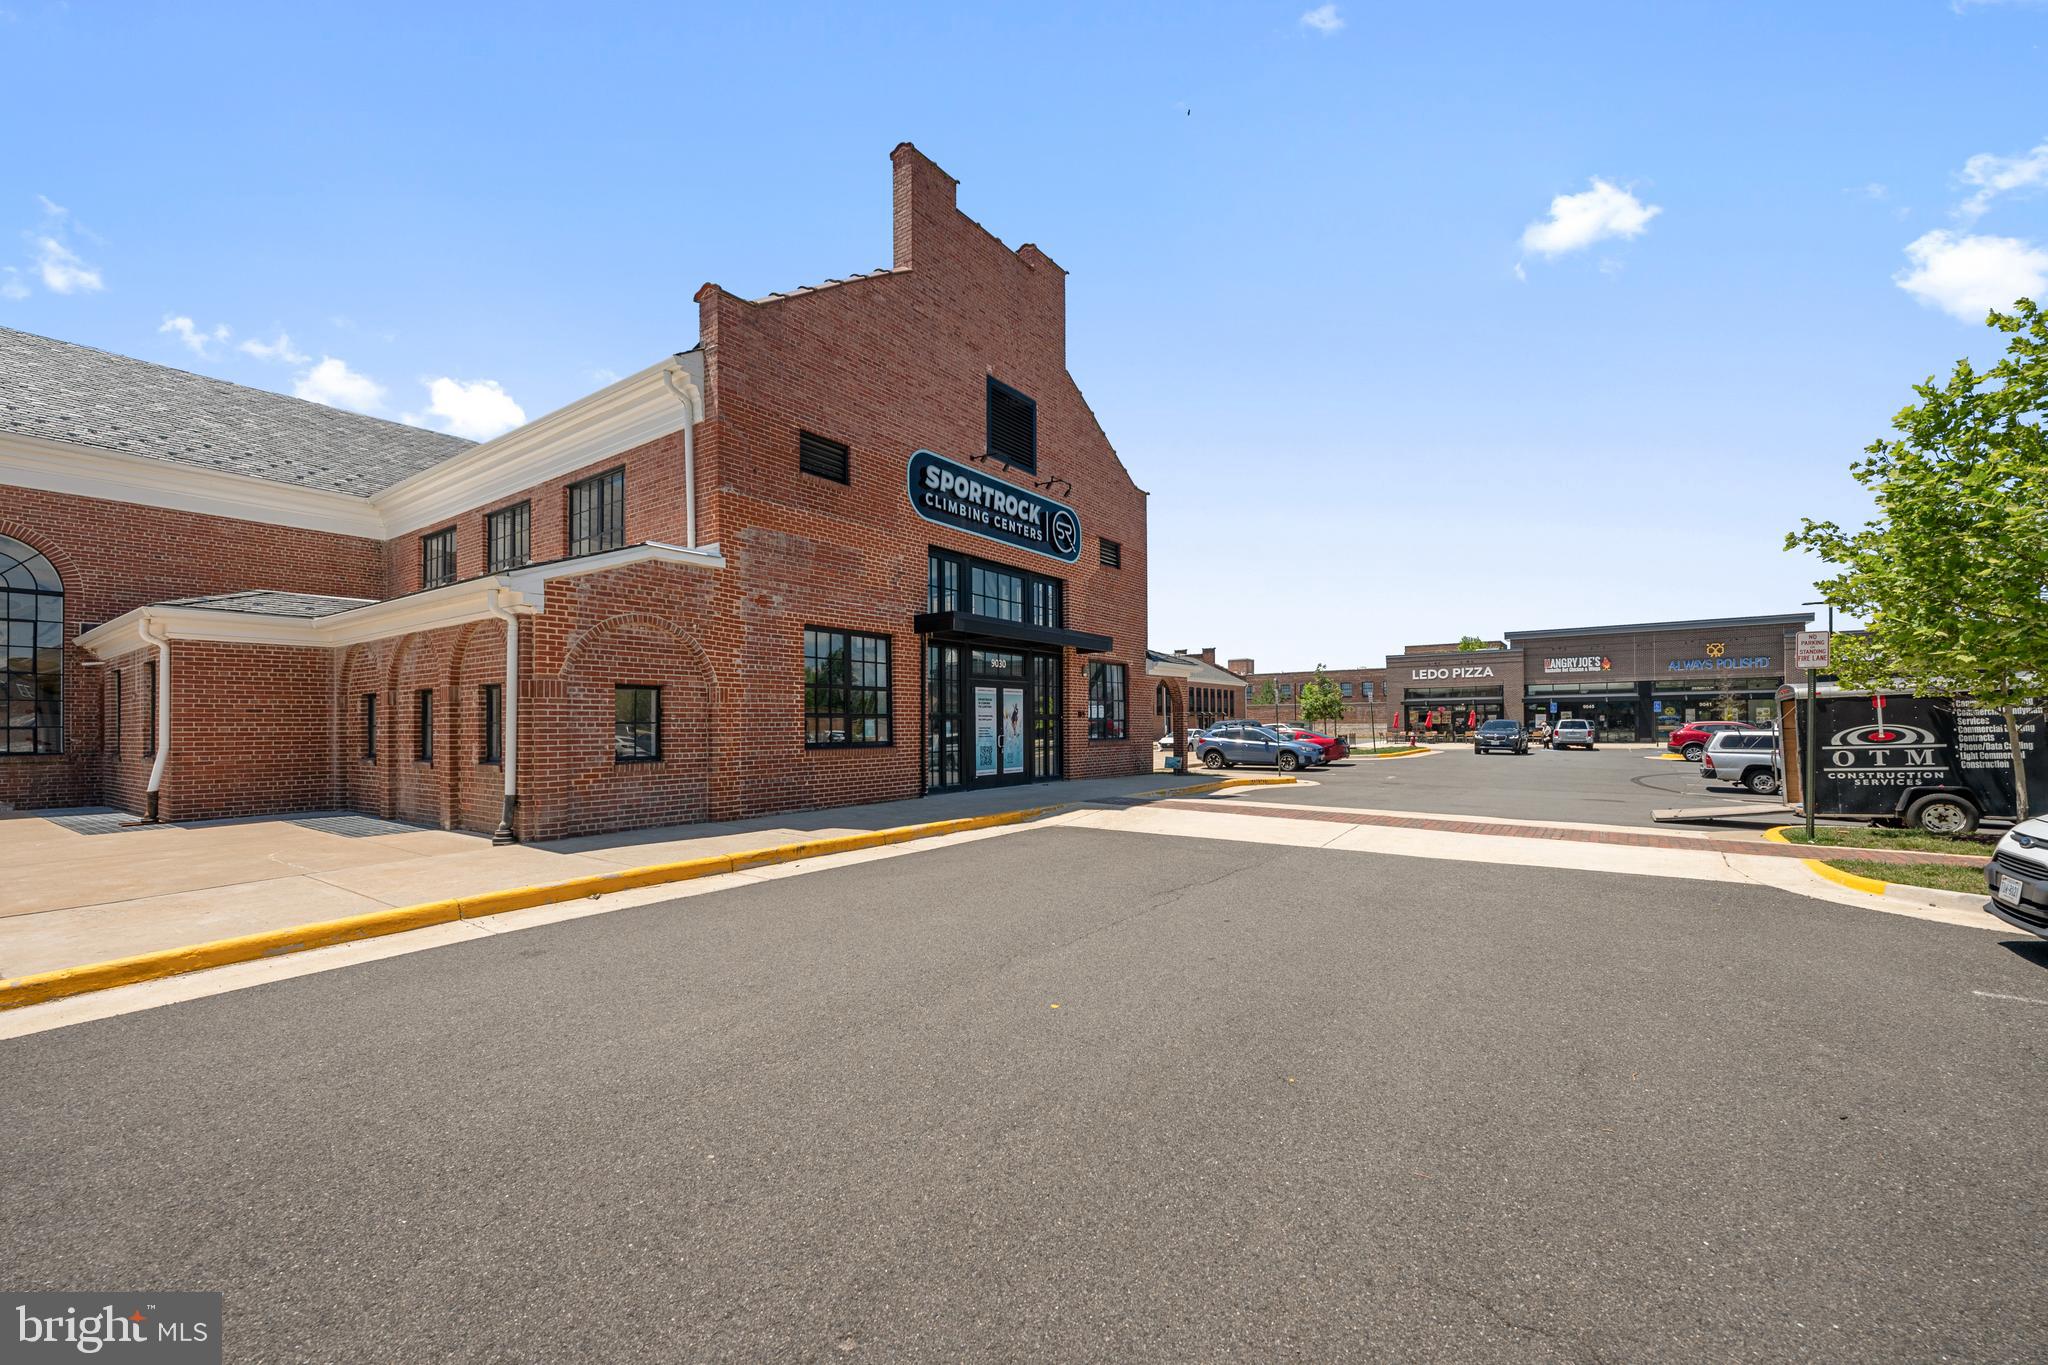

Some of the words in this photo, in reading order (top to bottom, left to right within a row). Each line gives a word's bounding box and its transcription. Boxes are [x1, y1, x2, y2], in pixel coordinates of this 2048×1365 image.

[924, 464, 1042, 526] SPORTROCK
[925, 492, 990, 524] CLIMBING
[993, 515, 1043, 542] CENTERS
[990, 658, 1007, 669] 9030
[1578, 656, 1601, 667] JOE'S
[1668, 658, 1714, 672] ALWAYS
[1716, 656, 1770, 670] POLISH'D
[1412, 668, 1449, 680] LEDO
[1452, 666, 1494, 679] PIZZA
[1957, 717, 1990, 726] Services
[1958, 725, 2003, 734] Commercial
[1958, 733, 1995, 742] Contracts
[1959, 742, 2003, 751] Phone/Data
[2004, 741, 2034, 751] Caling
[1960, 751, 1979, 761] Light
[1979, 751, 2026, 760] Commeral
[1960, 760, 2010, 769] Construction
[1827, 771, 1945, 780] CONSTRUCTION
